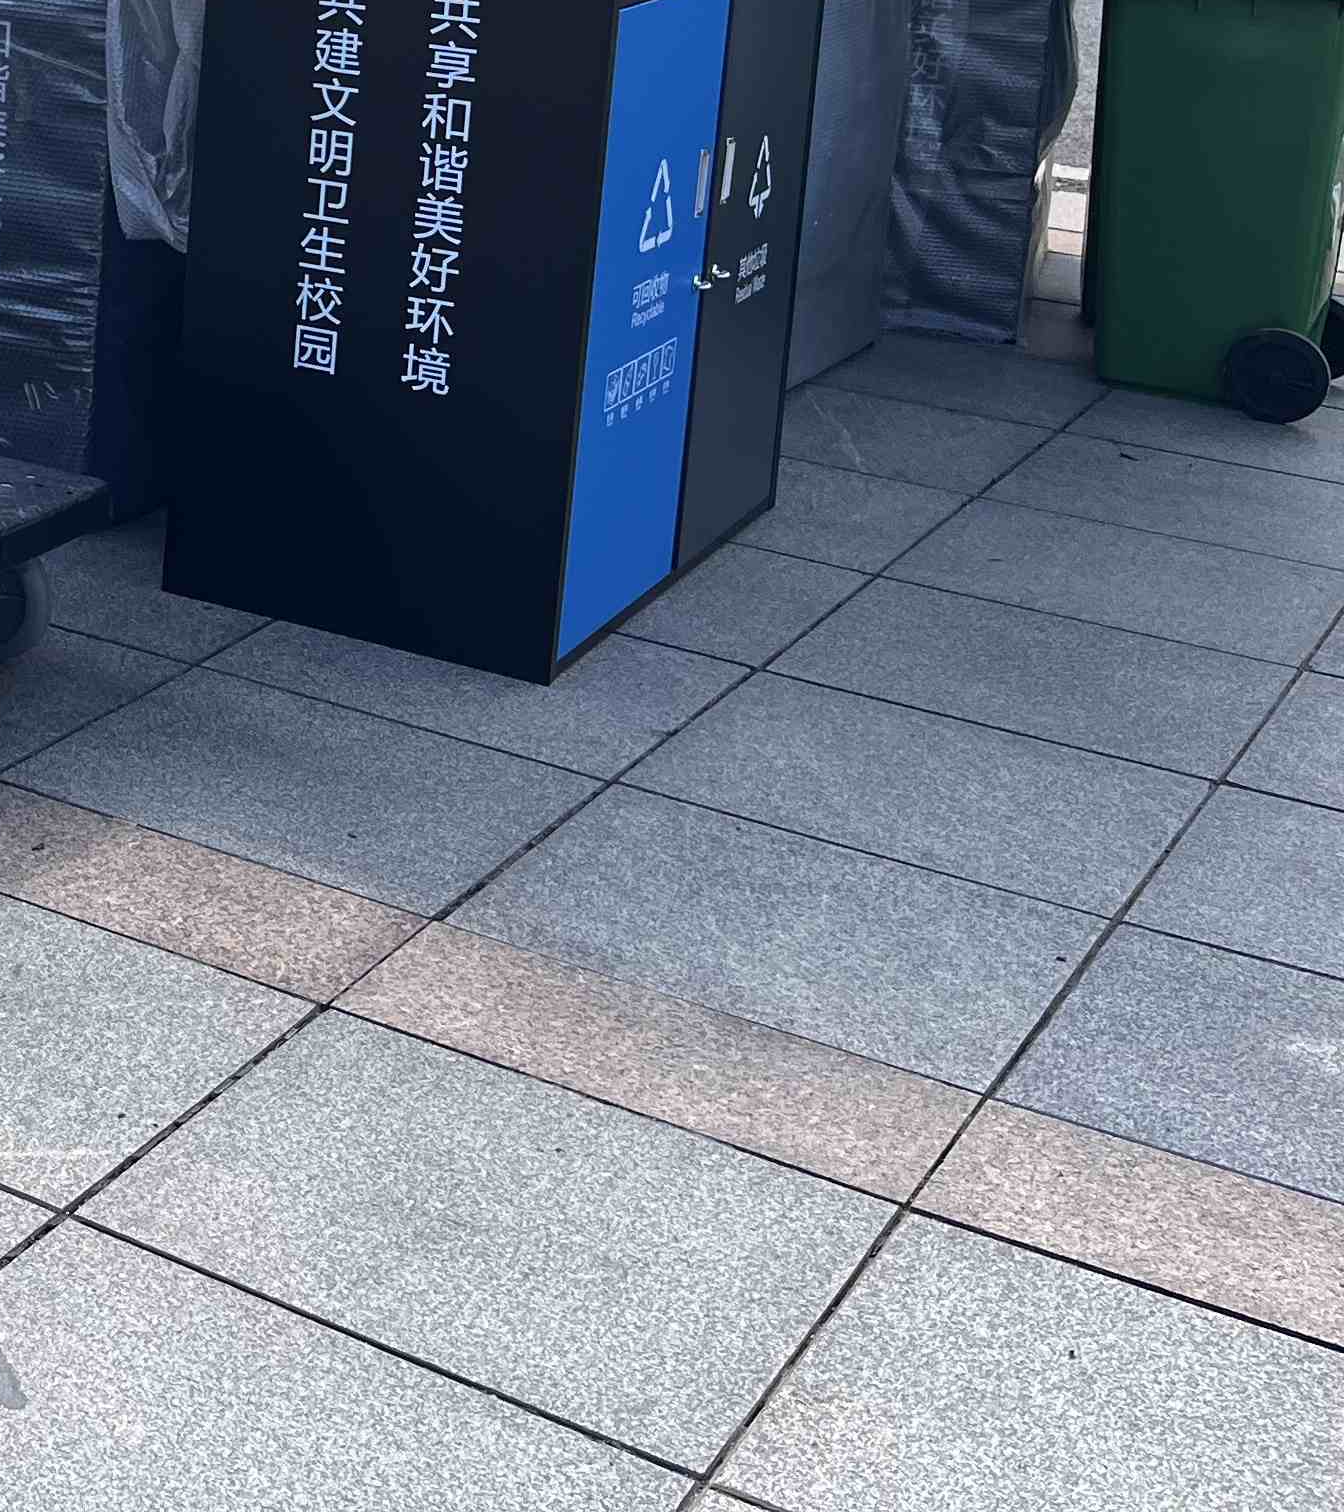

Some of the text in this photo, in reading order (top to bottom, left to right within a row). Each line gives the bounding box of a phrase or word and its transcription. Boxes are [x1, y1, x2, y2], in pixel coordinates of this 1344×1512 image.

[632, 271, 671, 308] 可回收物
[630, 301, 666, 329] Recyclable
